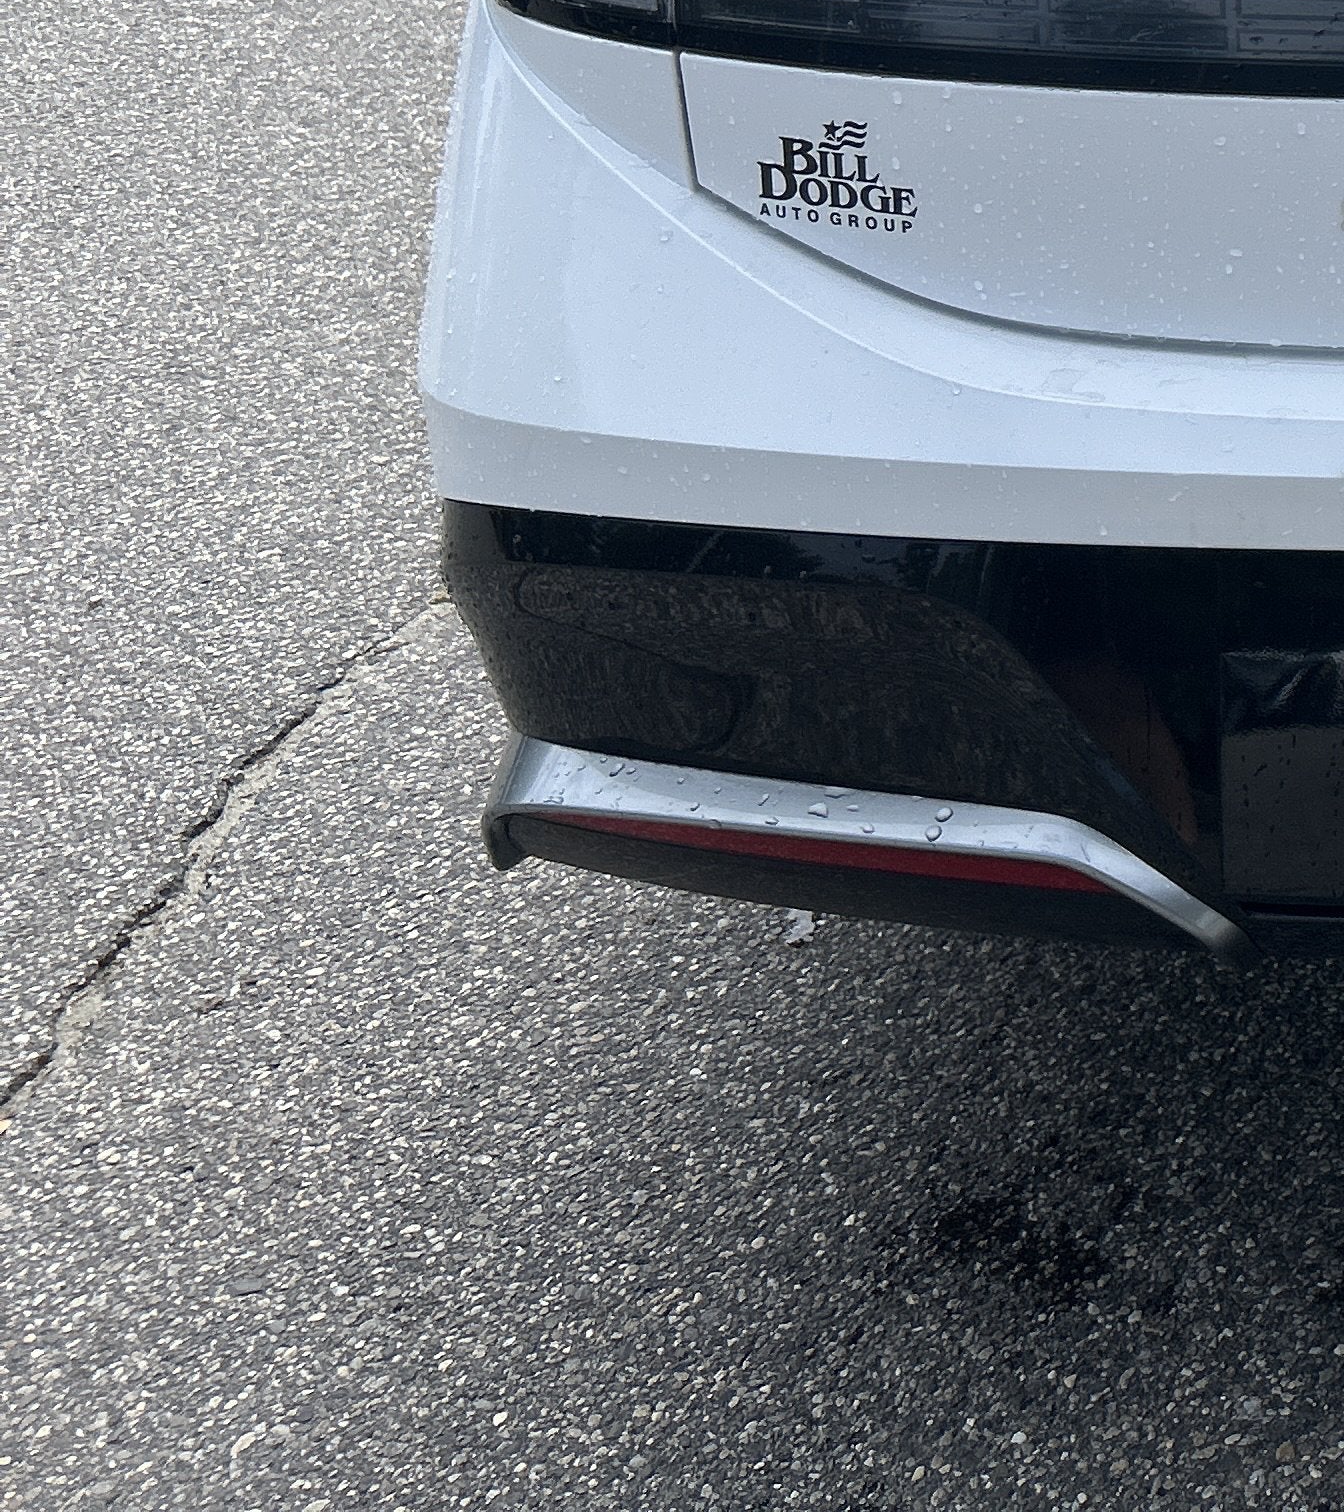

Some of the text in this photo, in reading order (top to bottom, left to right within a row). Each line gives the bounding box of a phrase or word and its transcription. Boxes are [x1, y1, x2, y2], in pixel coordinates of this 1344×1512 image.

[779, 136, 880, 183] BILL
[757, 161, 918, 218] DODGE
[760, 203, 914, 233] AUTO GROUP
